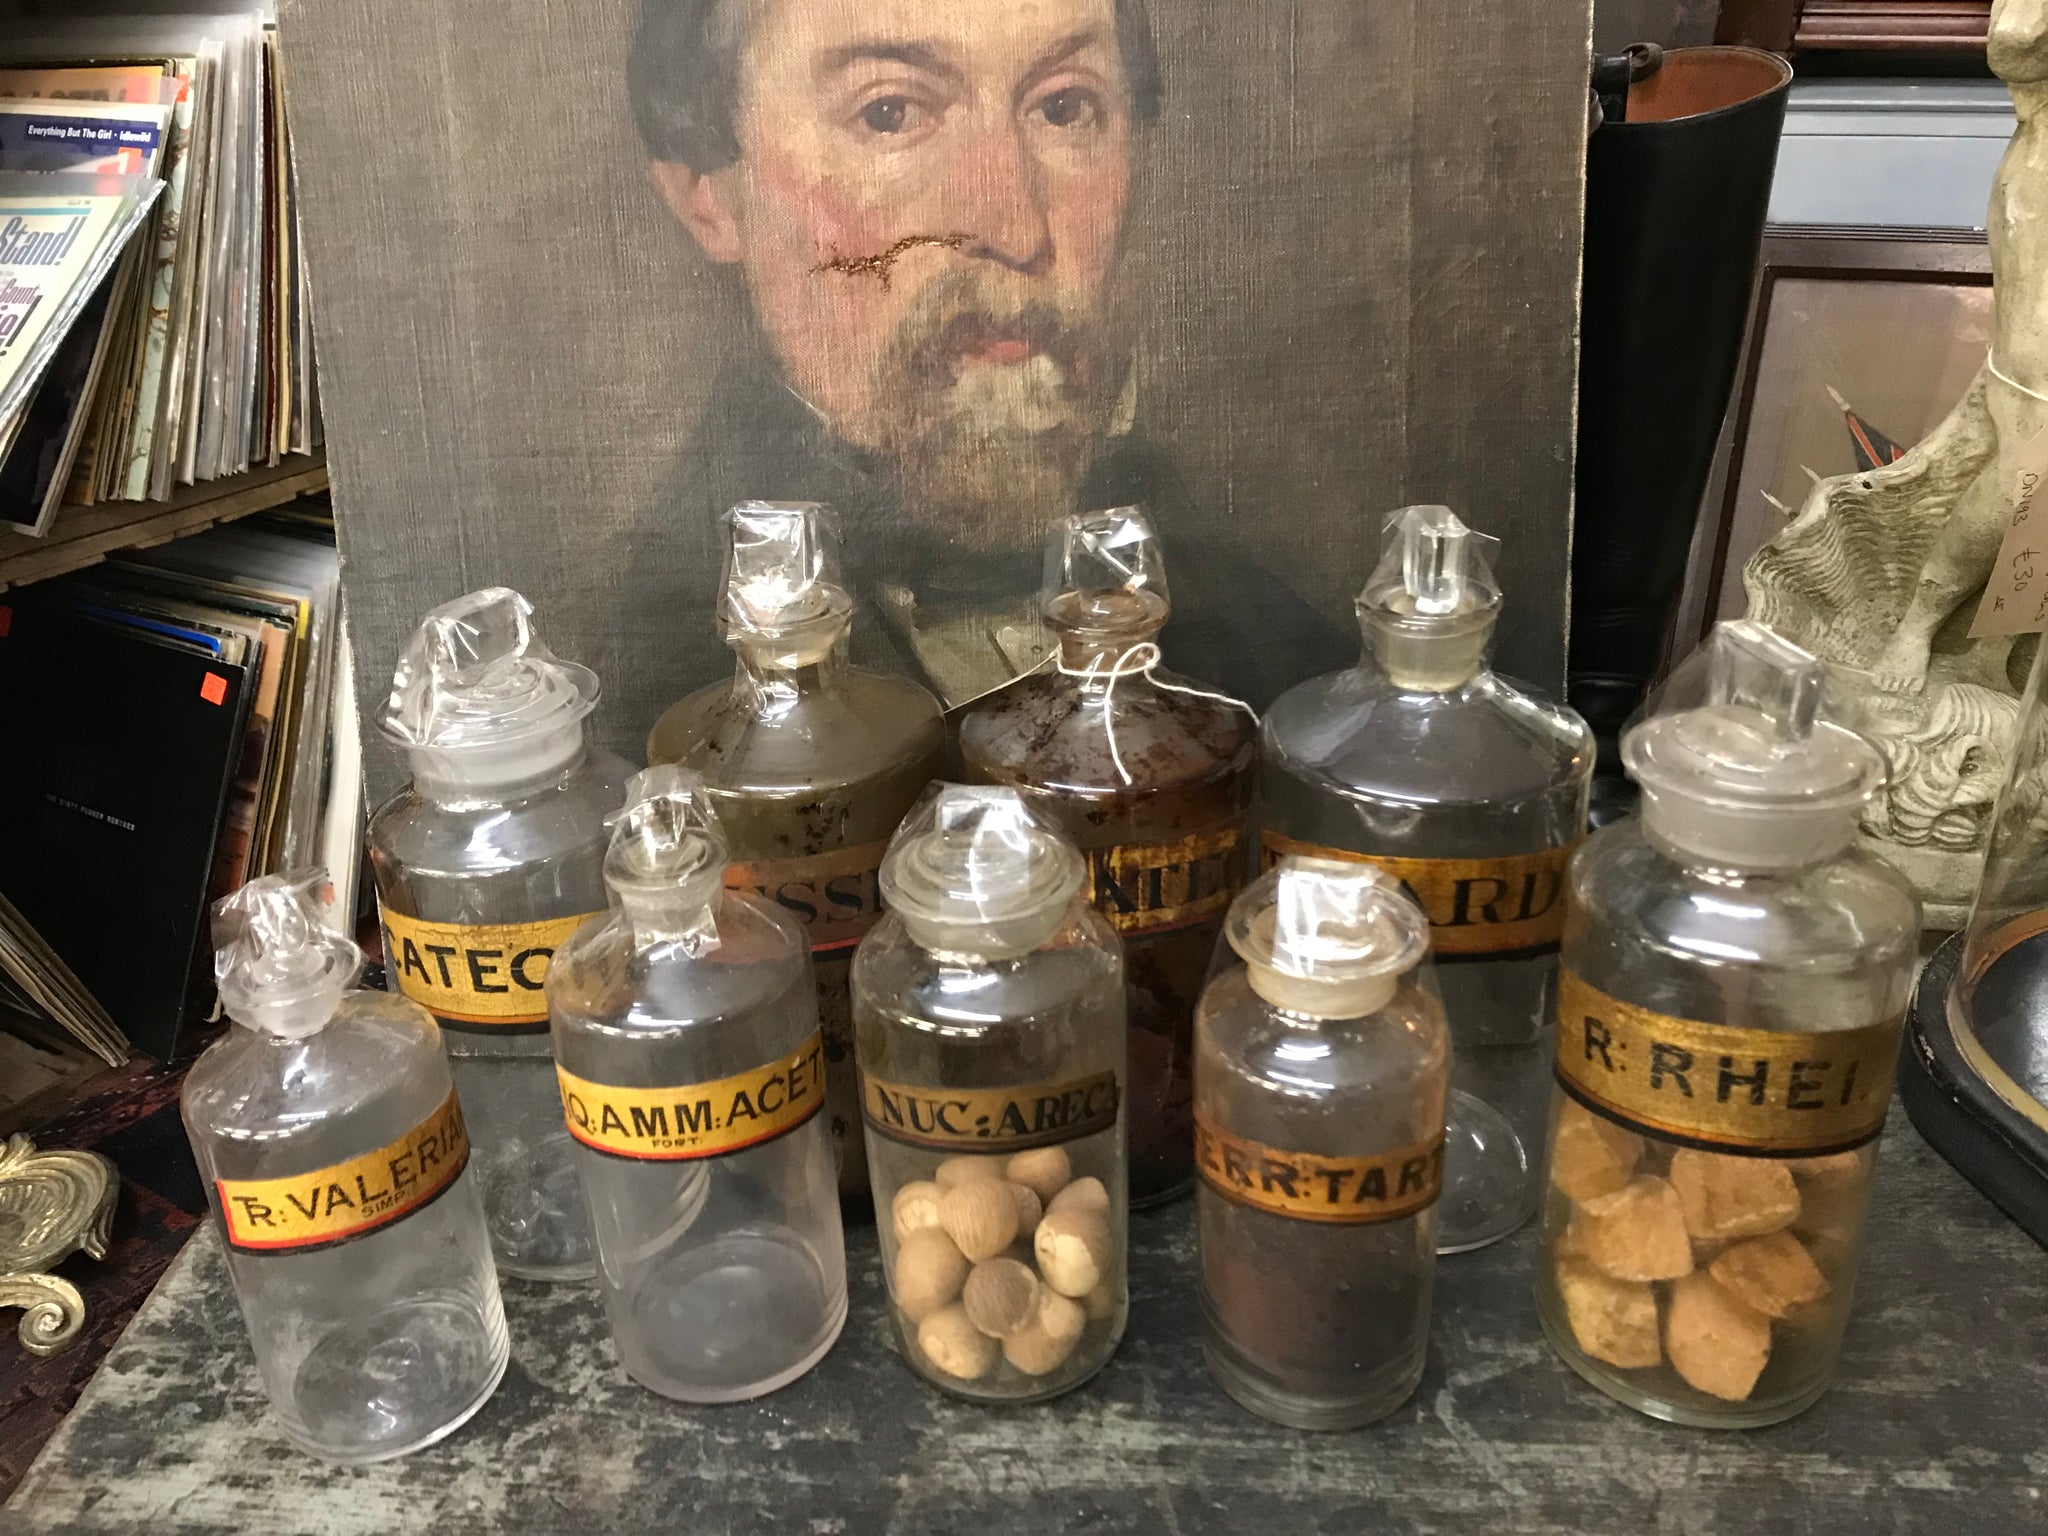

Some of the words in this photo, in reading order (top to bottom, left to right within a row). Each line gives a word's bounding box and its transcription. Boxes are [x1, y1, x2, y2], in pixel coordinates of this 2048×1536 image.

[28, 125, 66, 138] Everything
[67, 127, 81, 138] But
[82, 128, 97, 139] The
[98, 129, 112, 140] Girl
